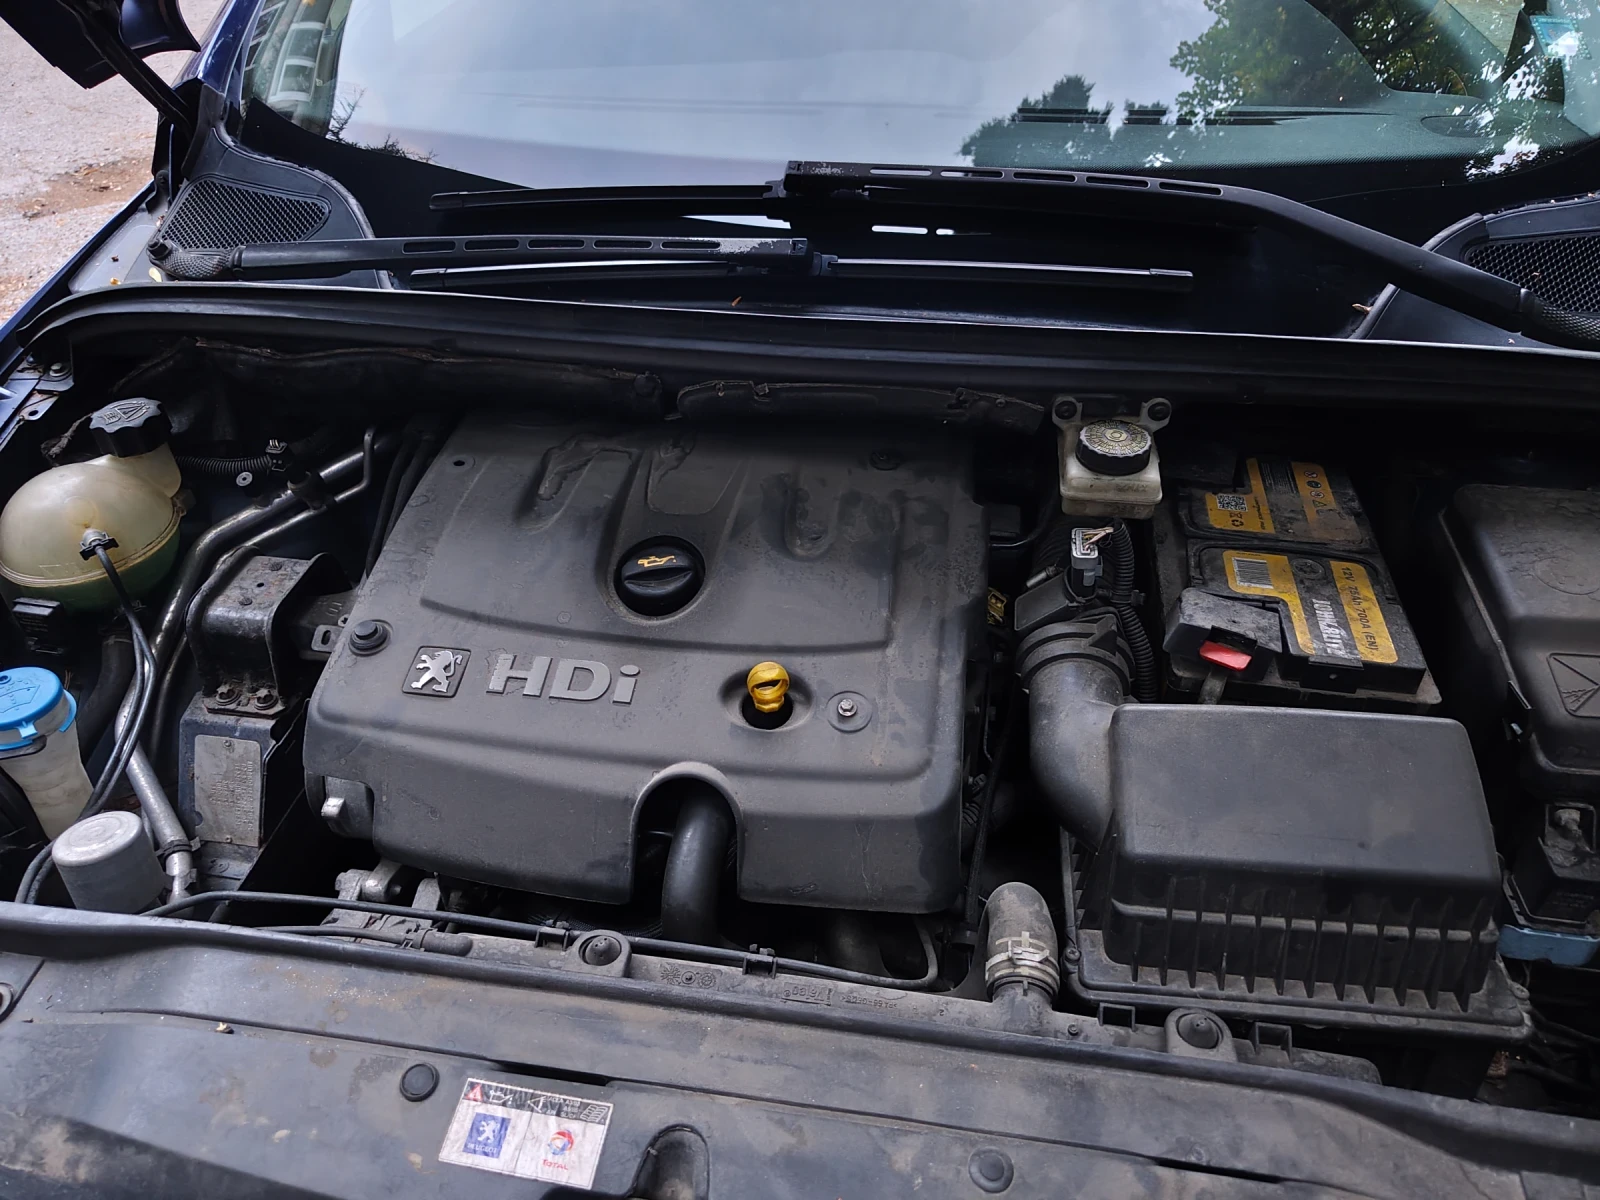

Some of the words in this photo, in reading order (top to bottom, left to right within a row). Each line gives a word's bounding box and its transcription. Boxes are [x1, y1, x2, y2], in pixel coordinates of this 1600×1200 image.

[1341, 566, 1356, 582] 12V
[1348, 585, 1362, 606] 75Ah
[1356, 608, 1371, 629] 700A
[1362, 631, 1379, 651] (EN)
[486, 653, 640, 704] HDi
[542, 1159, 569, 1170] TOTAL
